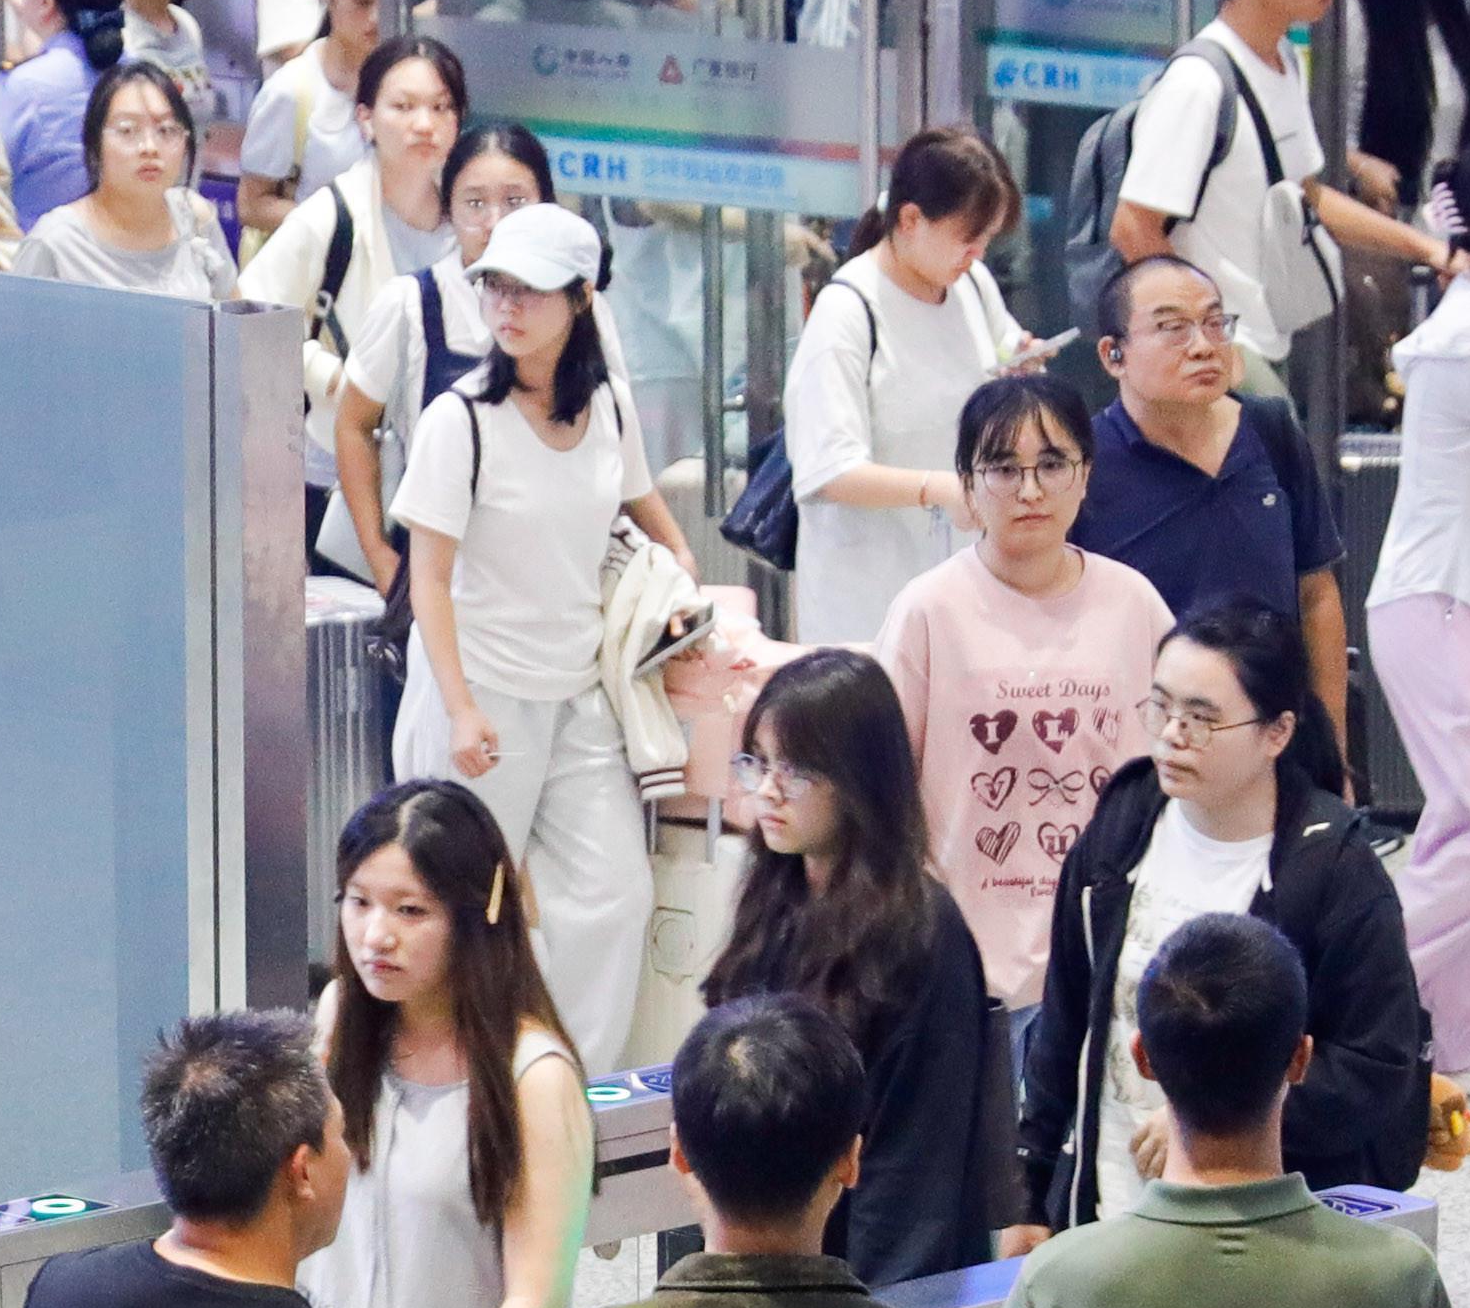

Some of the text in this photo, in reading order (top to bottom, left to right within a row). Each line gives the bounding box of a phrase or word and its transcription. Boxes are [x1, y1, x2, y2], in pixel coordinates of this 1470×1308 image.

[1022, 61, 1080, 91] CRH
[557, 150, 628, 182] CRH
[996, 678, 1111, 703] Sweet Days
